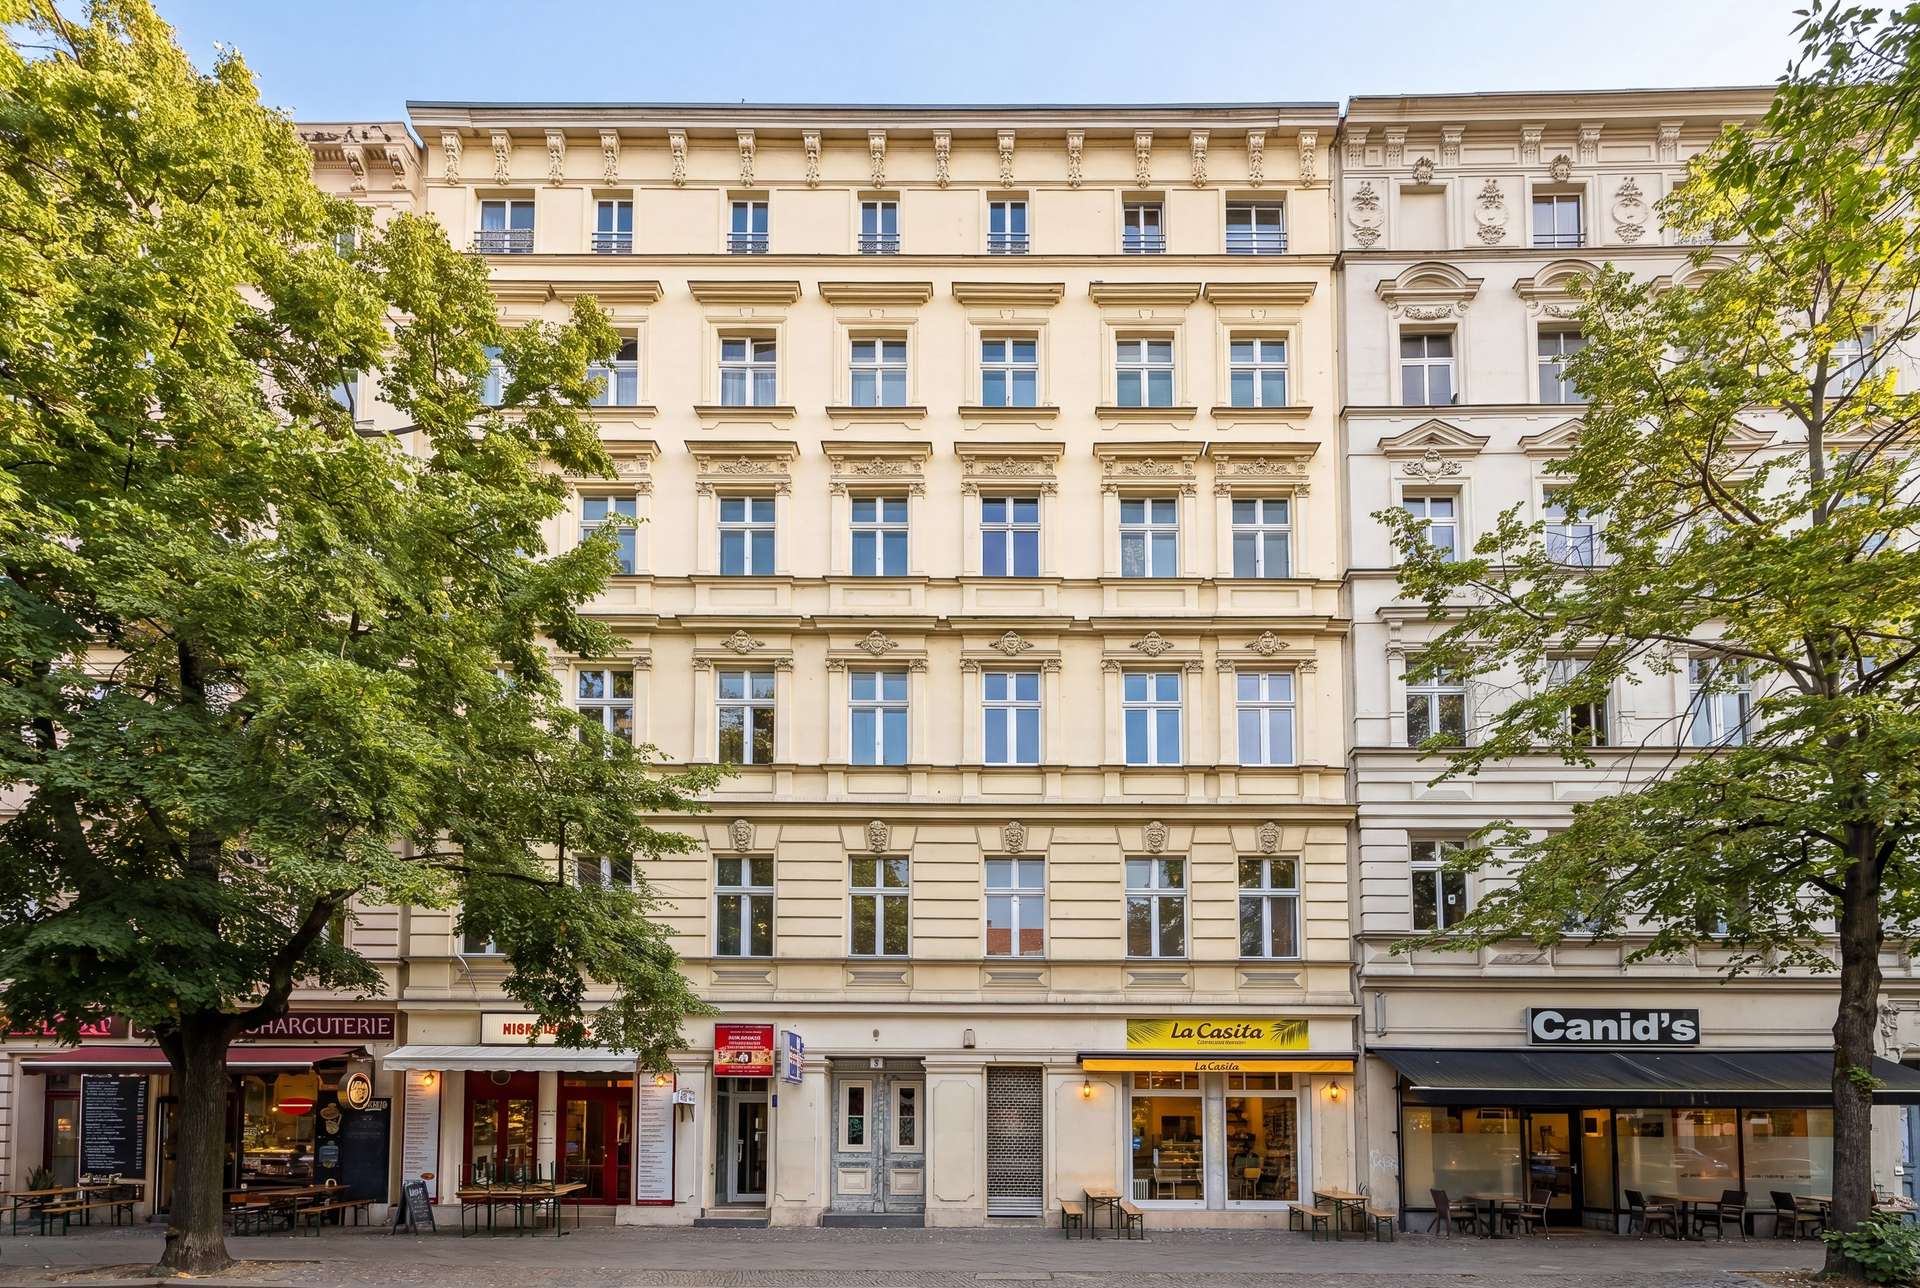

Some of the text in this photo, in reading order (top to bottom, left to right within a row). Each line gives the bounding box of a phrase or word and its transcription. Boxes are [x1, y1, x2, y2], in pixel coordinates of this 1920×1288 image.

[1170, 1022, 1265, 1040] La Casita
[1532, 1010, 1697, 1041] Canid's
[1194, 1061, 1240, 1071] La Casita
